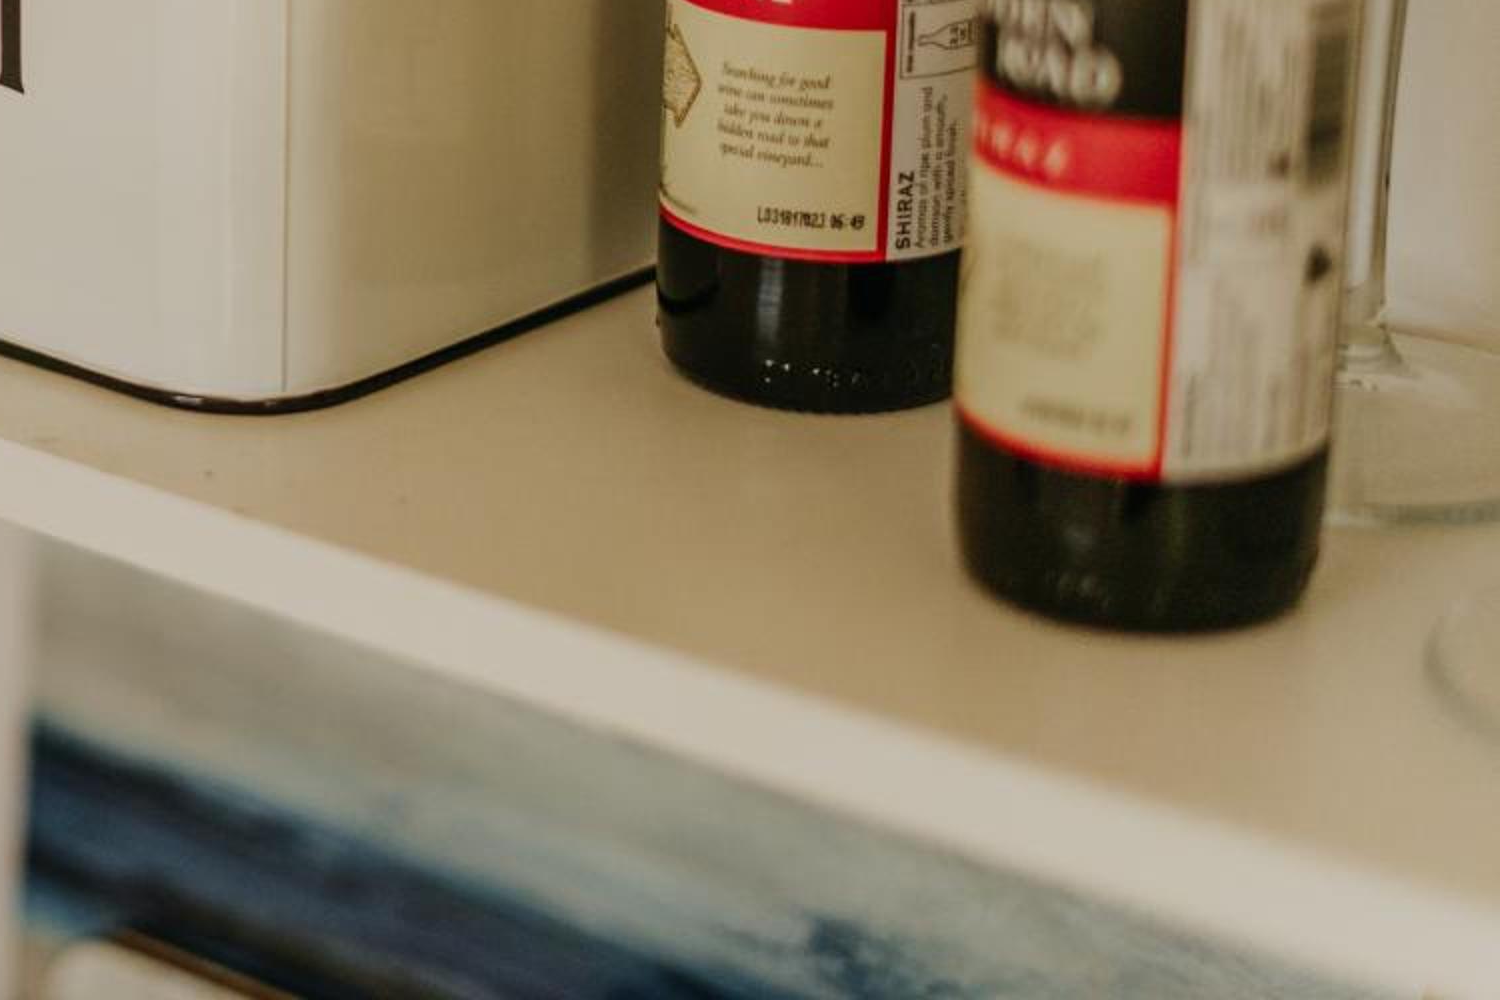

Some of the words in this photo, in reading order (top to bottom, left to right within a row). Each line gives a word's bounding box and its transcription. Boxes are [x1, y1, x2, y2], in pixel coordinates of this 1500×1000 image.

[797, 74, 832, 92] good
[747, 91, 765, 102] can
[770, 92, 835, 110] sometimes
[748, 111, 771, 125] you
[803, 132, 830, 149] that
[895, 171, 915, 250] SHIRAZ
